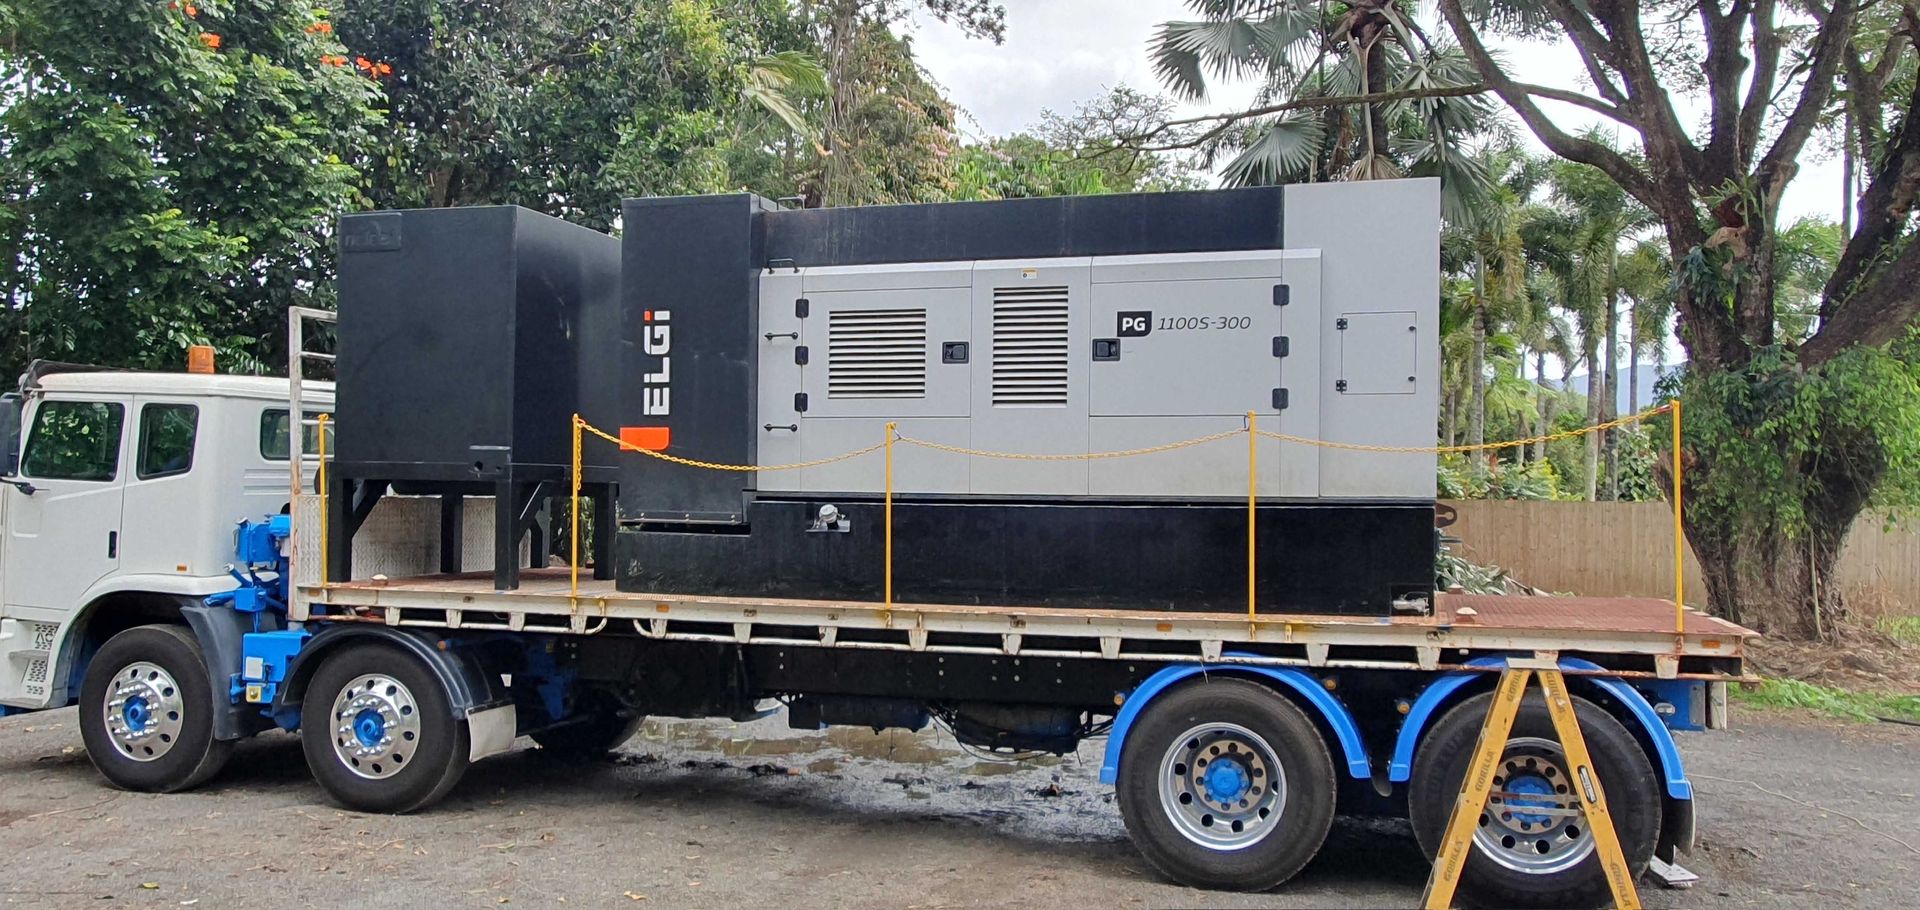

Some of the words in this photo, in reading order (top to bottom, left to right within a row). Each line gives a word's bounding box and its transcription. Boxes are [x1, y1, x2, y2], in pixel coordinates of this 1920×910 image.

[1121, 316, 1146, 332] PG
[1157, 316, 1252, 331] 1100S-300
[1475, 751, 1496, 792] GORILLA
